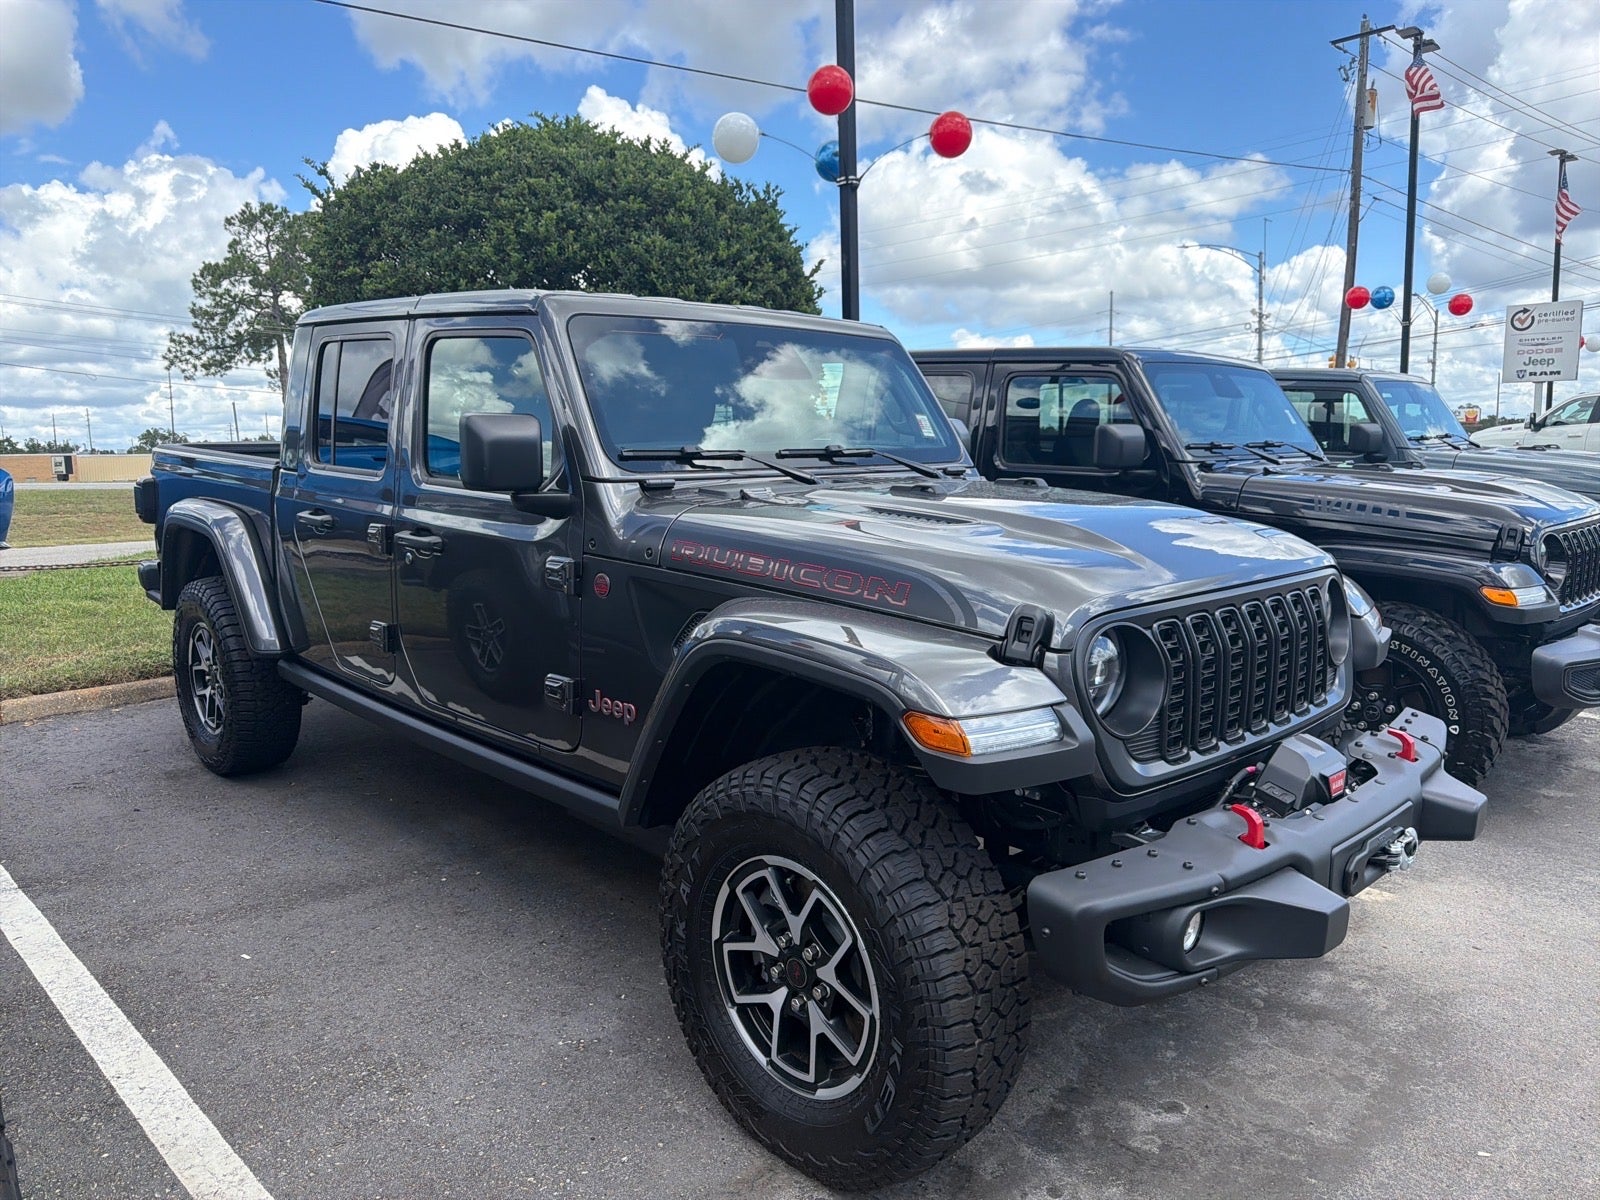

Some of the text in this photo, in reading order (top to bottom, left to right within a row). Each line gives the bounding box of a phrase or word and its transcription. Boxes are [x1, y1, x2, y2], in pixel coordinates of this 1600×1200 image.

[1538, 309, 1575, 317] certified
[1537, 316, 1574, 324] pre-owned
[1517, 347, 1563, 355] DODGE
[1523, 356, 1555, 366] Jeep
[672, 540, 911, 606] RUBICON
[1390, 640, 1459, 720] STINATION
[588, 689, 637, 726] Jeep
